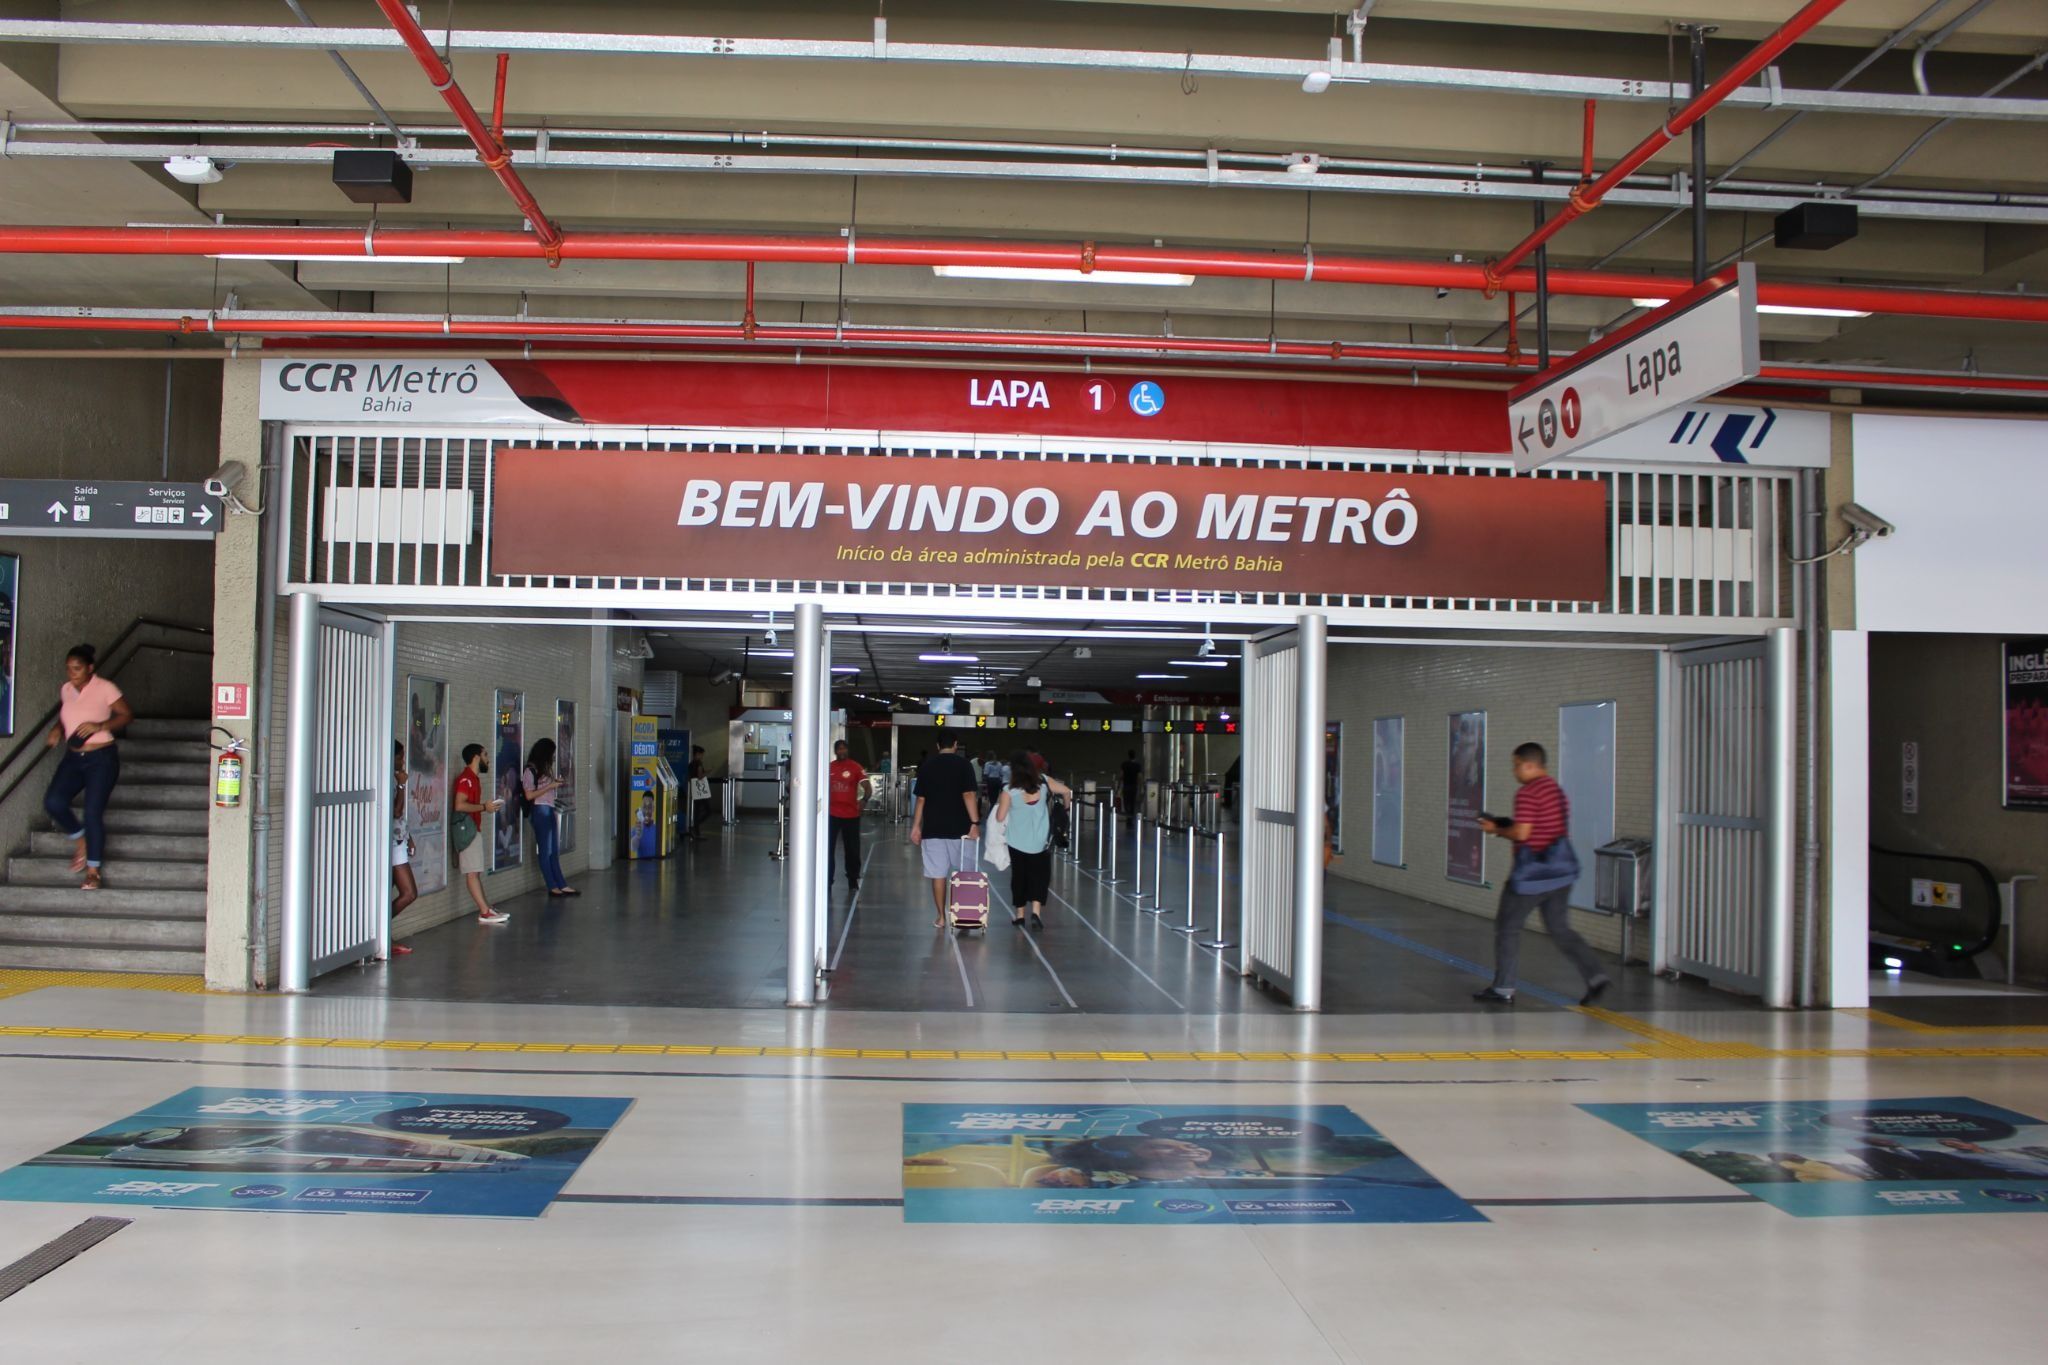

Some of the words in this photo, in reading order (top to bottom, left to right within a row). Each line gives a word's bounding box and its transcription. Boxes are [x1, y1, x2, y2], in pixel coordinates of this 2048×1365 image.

[1626, 340, 1682, 396] Lapa
[279, 362, 357, 392] CCR
[366, 363, 479, 394] Metrô
[970, 378, 1050, 408] LAPA
[1088, 384, 1102, 410] 1
[362, 397, 412, 412] Bahia
[1565, 398, 1575, 429] 1
[74, 486, 98, 495] Saída
[149, 488, 186, 498] Serviços
[677, 479, 1060, 535] BEM-VINDO
[1075, 490, 1178, 538] AO
[1196, 487, 1419, 546] METRÔ
[836, 545, 885, 562] Início
[890, 546, 912, 562] da
[918, 547, 957, 563] área
[963, 548, 1080, 566] administrada
[1085, 551, 1124, 570] pela
[1130, 552, 1170, 568] CCR
[1174, 553, 1229, 570] Metrô
[1234, 555, 1283, 572] Bahia
[634, 742, 655, 755] DÉBITO
[197, 1102, 339, 1115] BRT
[417, 1117, 538, 1125] Rodoviária
[950, 1117, 1082, 1130] BRT
[1650, 1115, 1762, 1128] BRT
[106, 1180, 221, 1193] BRT
[1875, 1189, 1961, 1202] BRT
[1031, 1199, 1135, 1210] BRT
